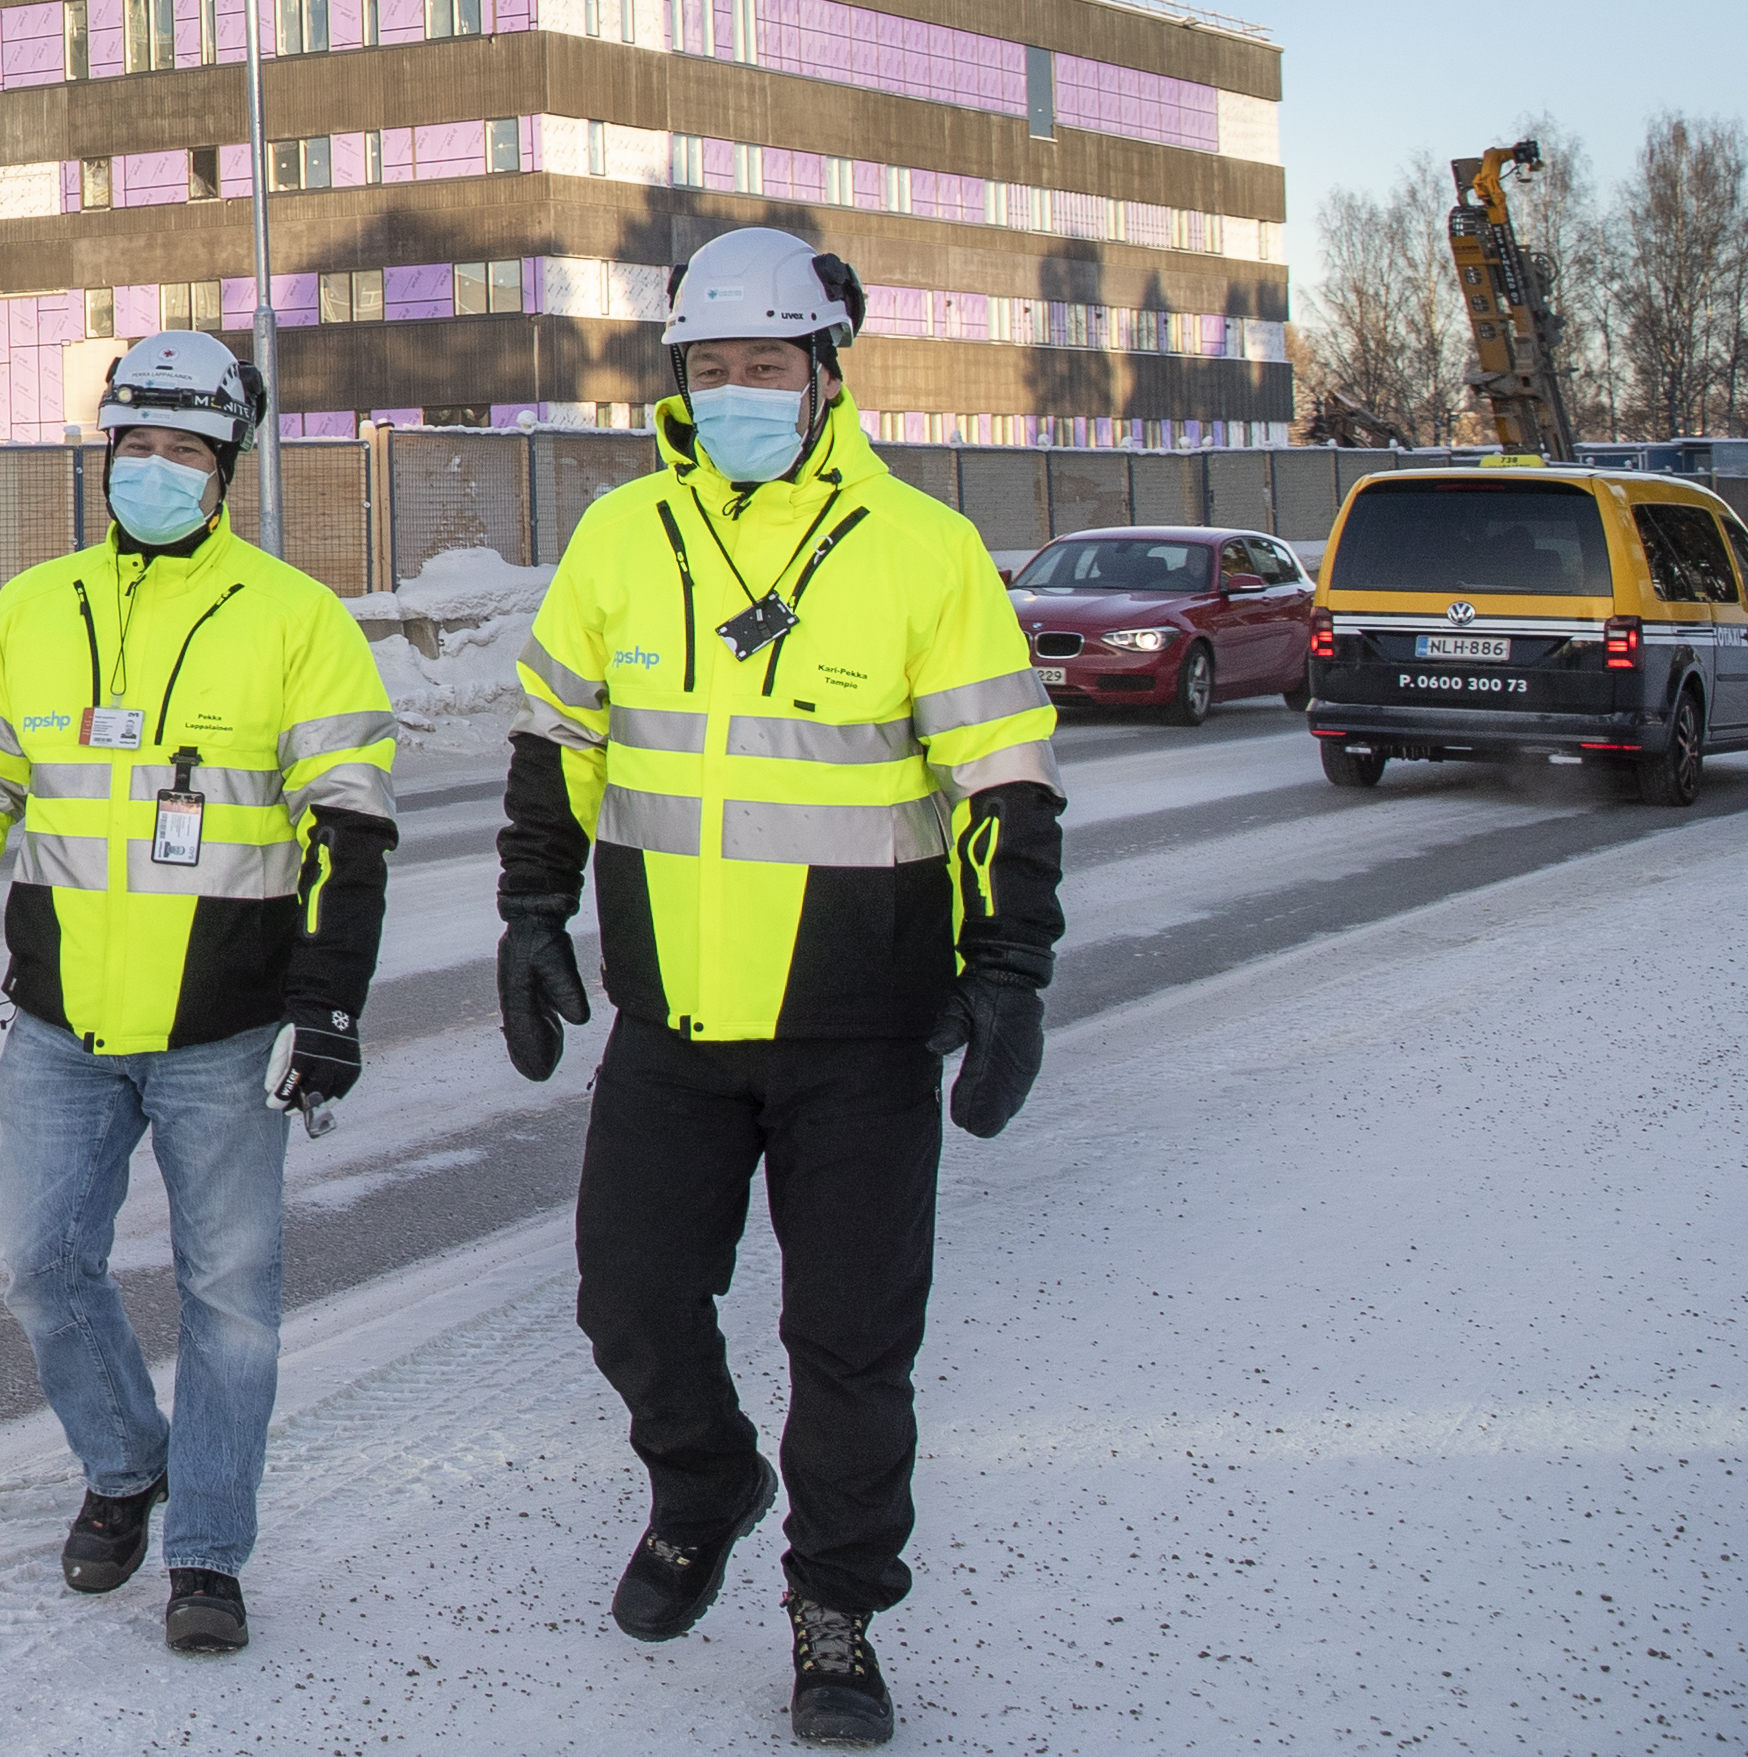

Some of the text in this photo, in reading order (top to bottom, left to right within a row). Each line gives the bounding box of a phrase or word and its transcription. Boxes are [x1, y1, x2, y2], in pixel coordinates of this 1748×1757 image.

[780, 312, 804, 320] uvex
[151, 371, 193, 380] LAPPALAINEN
[1500, 456, 1518, 464] 738
[1429, 639, 1504, 656] NLH-886
[817, 664, 868, 680] Kari-Pekka
[824, 676, 858, 689] Tampio
[1467, 677, 1502, 691] 300
[1507, 679, 1528, 693] 73
[23, 710, 71, 732] ppshp
[198, 713, 222, 721] Pekka
[185, 722, 233, 731] Lappalainen
